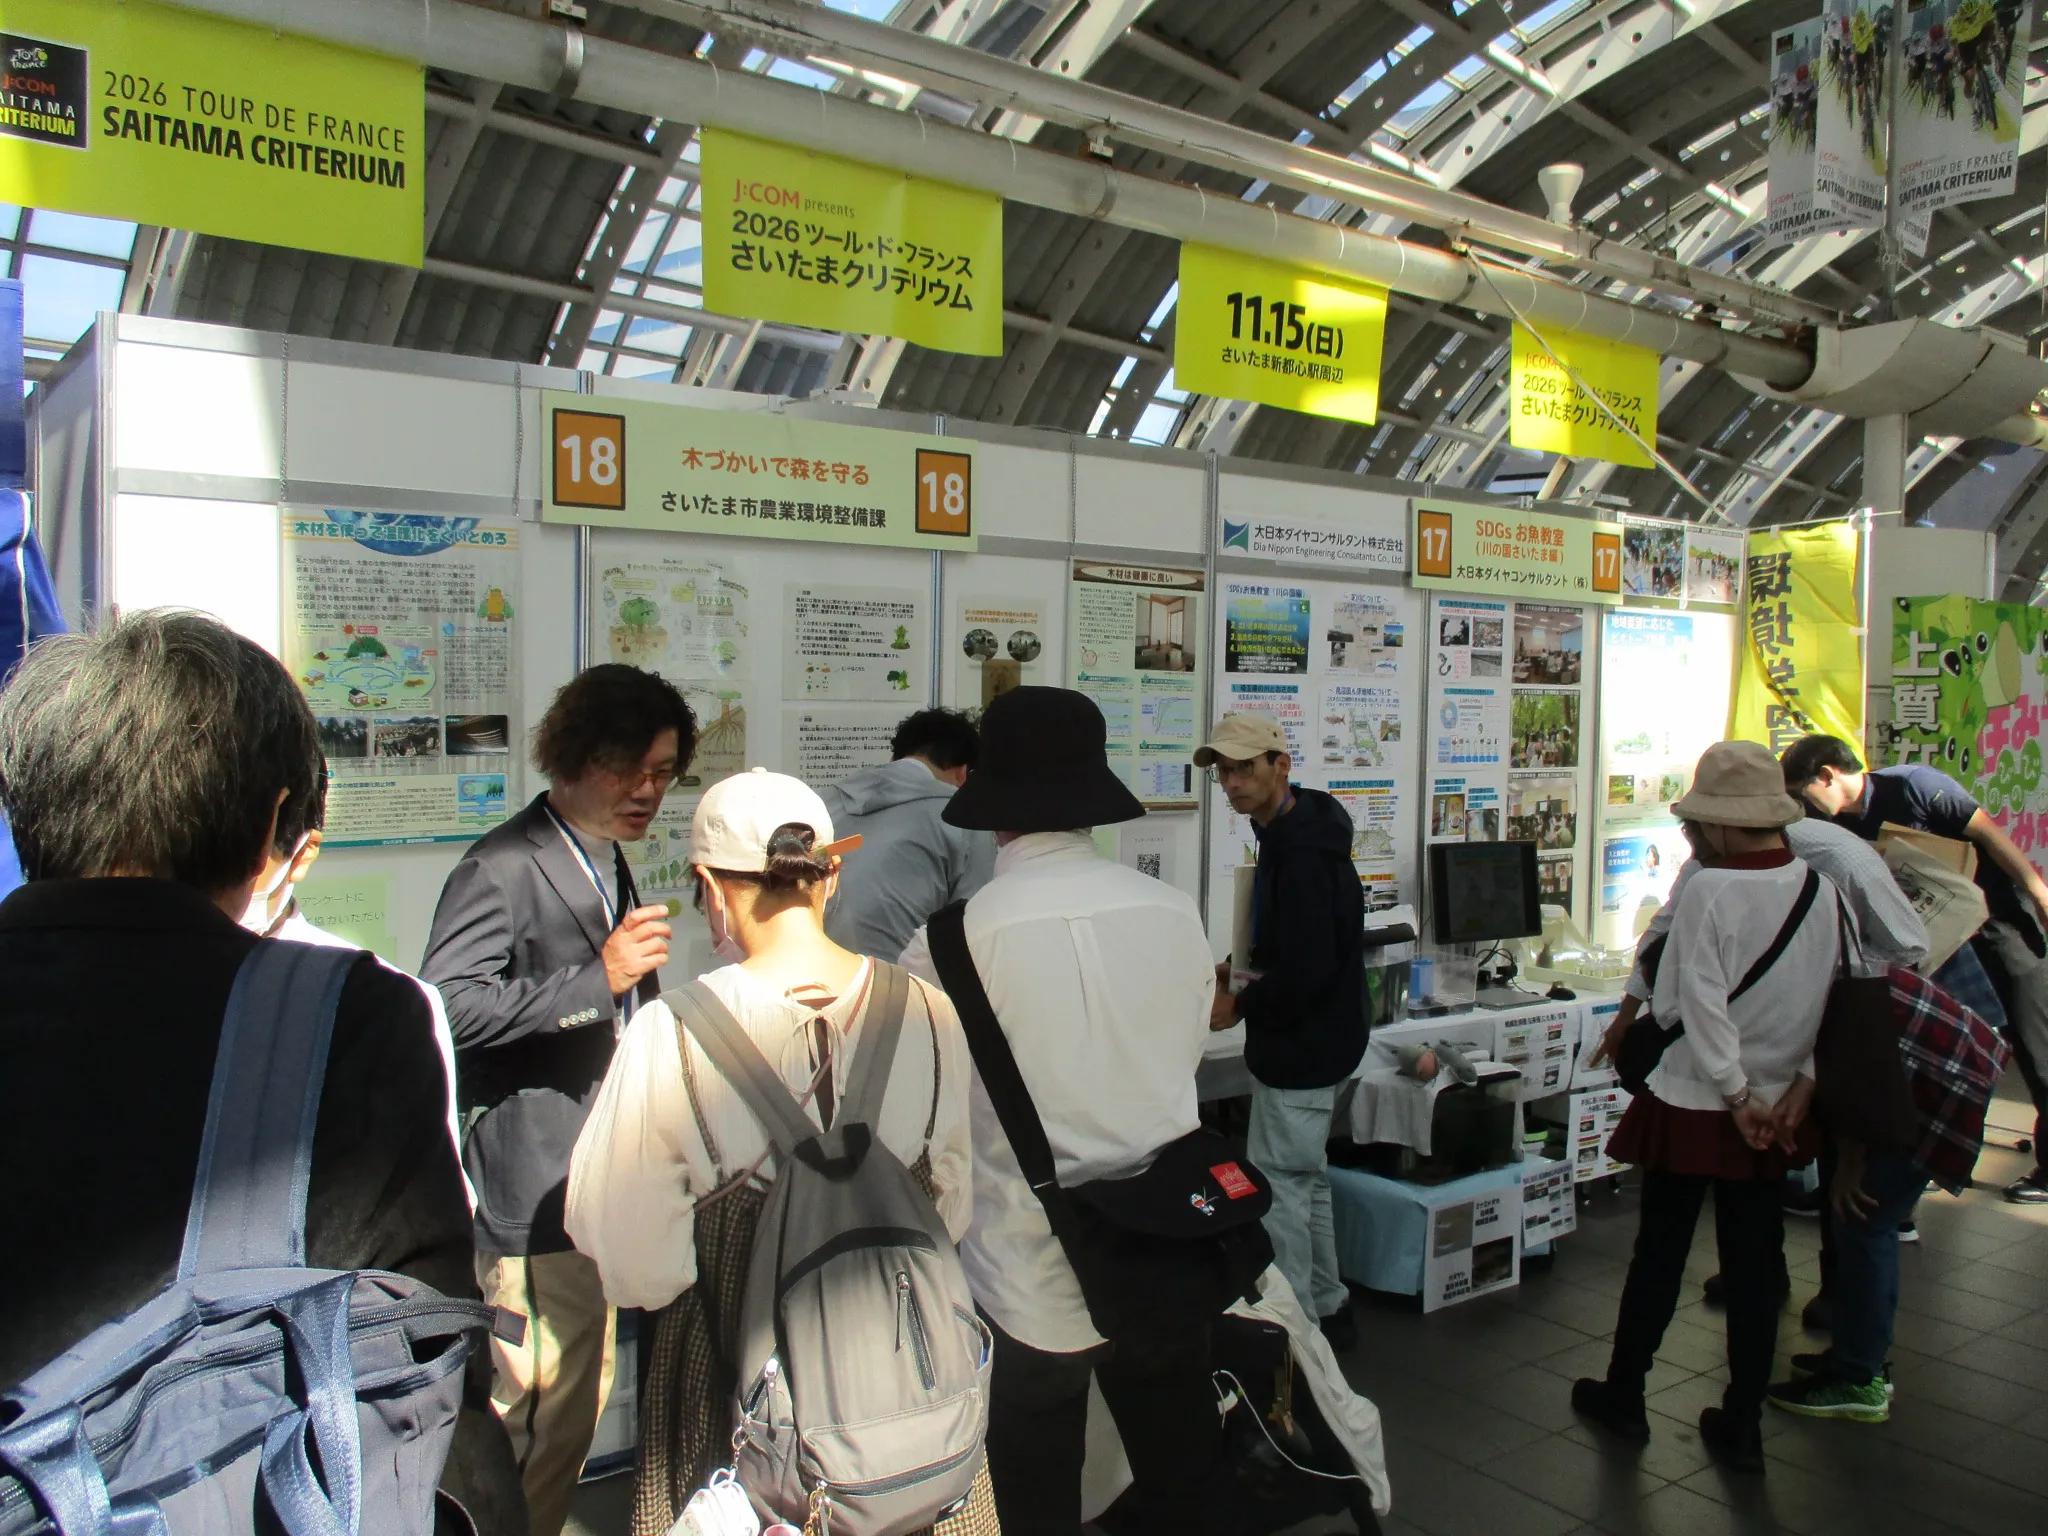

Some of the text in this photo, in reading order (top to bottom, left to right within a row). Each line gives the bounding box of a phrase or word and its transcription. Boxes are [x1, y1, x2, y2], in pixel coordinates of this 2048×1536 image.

[104, 70, 406, 154] 2026 TOUR DE FRANCE
[103, 105, 406, 190] SAITAMA CRITERIUM
[1966, 149, 2015, 169] FRANCE
[1942, 164, 2013, 191] CRITERIUM
[803, 197, 856, 219] presents
[1768, 211, 1812, 236] SAITAMA
[730, 240, 974, 312] さいたまクリテリウム
[1226, 291, 1345, 360] 11.15(日)
[1221, 346, 1344, 384] さいたま新都心駅周辺
[561, 434, 618, 487] 18
[680, 446, 871, 486] 木づかいで森を守る
[921, 471, 966, 517] 18
[660, 490, 887, 529] さいたま市農業環境整備課
[1254, 525, 1404, 552] 大日本ダイヤコンサルタント株式会社
[1422, 527, 1449, 563] 17
[1476, 519, 1565, 548] SDGs お魚教室
[1268, 543, 1293, 557] Nippon
[1295, 546, 1336, 560] Engineering
[1336, 550, 1376, 563] Consultants
[1595, 548, 1617, 579] 17
[1107, 567, 1173, 583] 木材は健康に良い
[1456, 565, 1569, 586] 大日本ダイヤコンサルタント
[300, 892, 365, 907] アンケートに
[306, 910, 386, 927] 協力いただい
